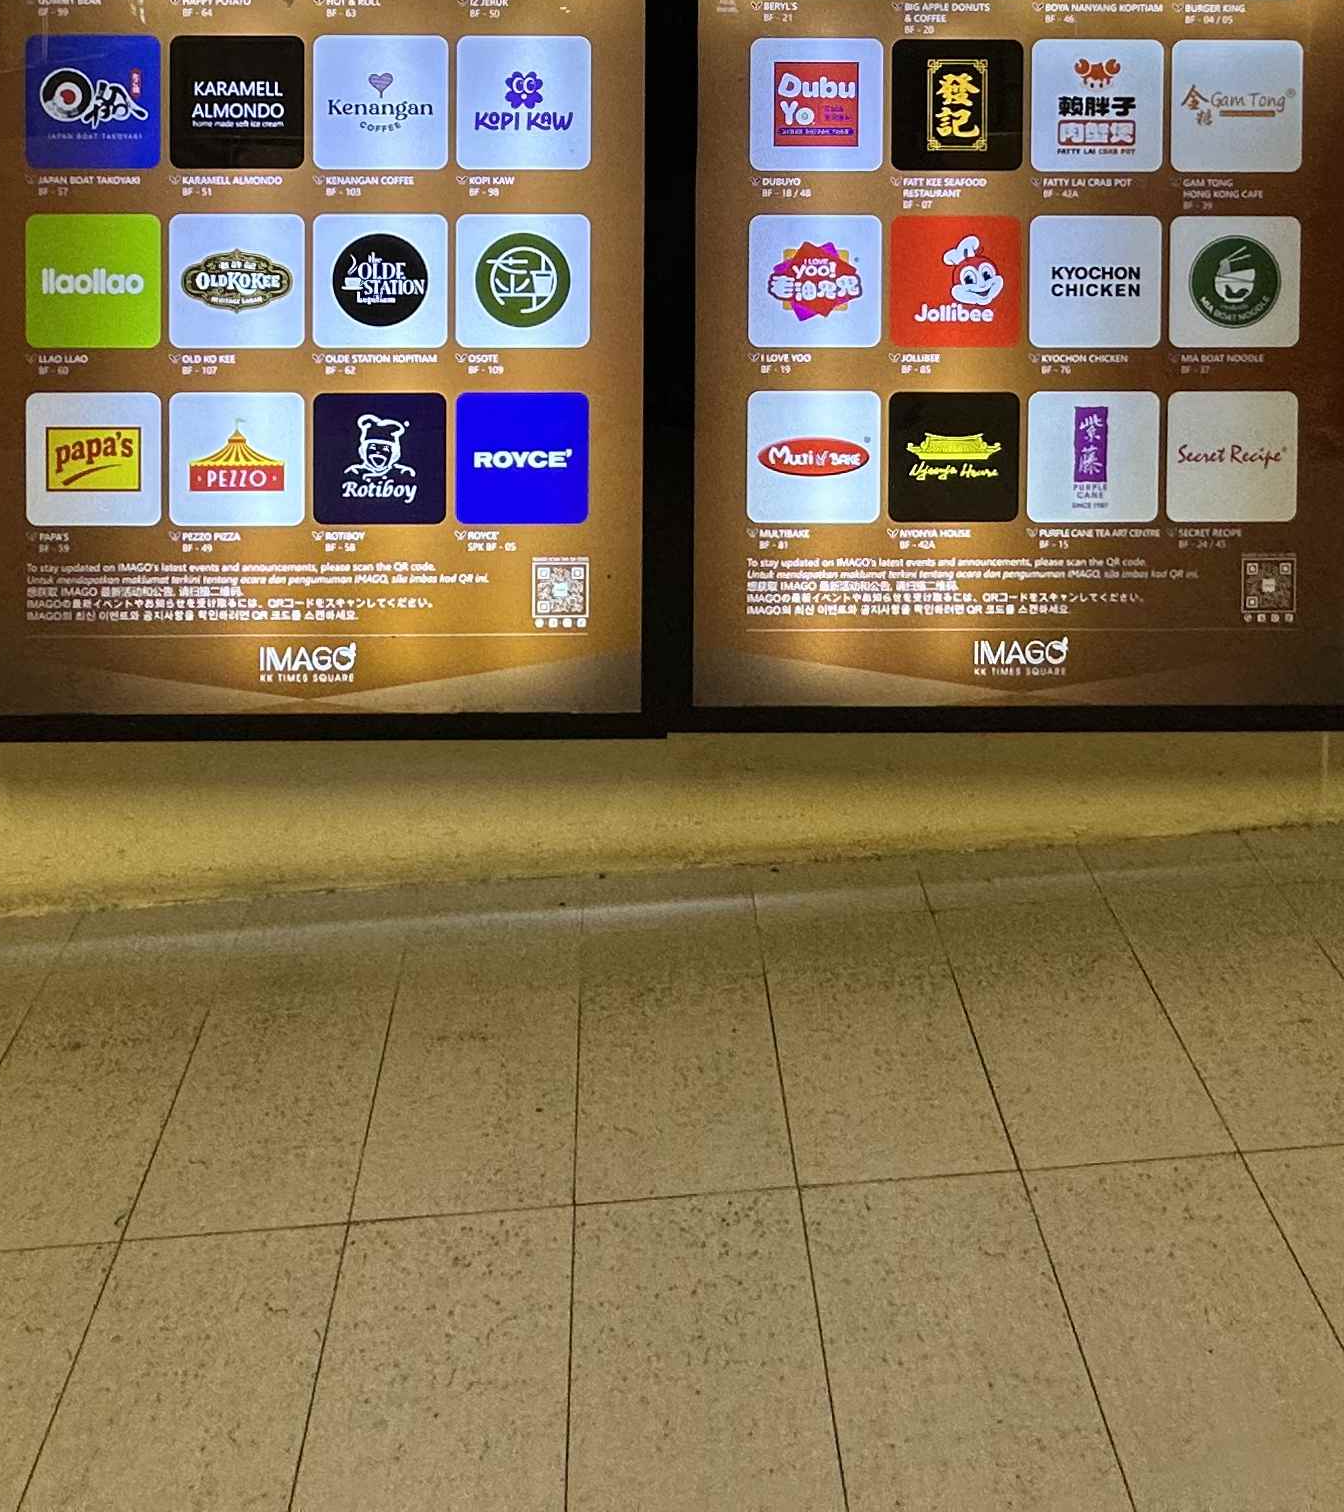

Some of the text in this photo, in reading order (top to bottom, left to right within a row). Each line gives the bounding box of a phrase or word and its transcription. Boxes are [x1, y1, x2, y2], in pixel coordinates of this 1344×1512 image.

[905, 3, 990, 11] BIG APPLE DONUTS
[1184, 3, 1245, 12] BURGER KING
[194, 81, 283, 96] KARAMELL
[778, 74, 855, 99] Dubu
[192, 103, 284, 122] ALMONDO
[328, 94, 433, 120] Kenangan
[780, 100, 814, 126] Yo
[937, 74, 980, 137] 發記
[360, 118, 404, 132] COFFEE
[475, 112, 519, 130] KOPI
[1043, 178, 1069, 186] FATTY
[1088, 178, 1113, 187] CRAB
[357, 261, 406, 281] OLDE
[1052, 267, 1140, 280] KYOCHON
[43, 268, 144, 294] llaollao
[364, 280, 425, 296] STATION
[1052, 284, 1140, 296] CHICKEN
[915, 303, 993, 322] Jollibee
[55, 432, 134, 473] papa's
[1178, 444, 1284, 469] Secret Recipe
[208, 470, 266, 487] PEZZO
[342, 477, 417, 503] Rotiboy
[325, 531, 365, 540] ROTIBOY
[260, 643, 356, 671] IMAGO
[260, 673, 353, 682] KK TIMES SQUARE
